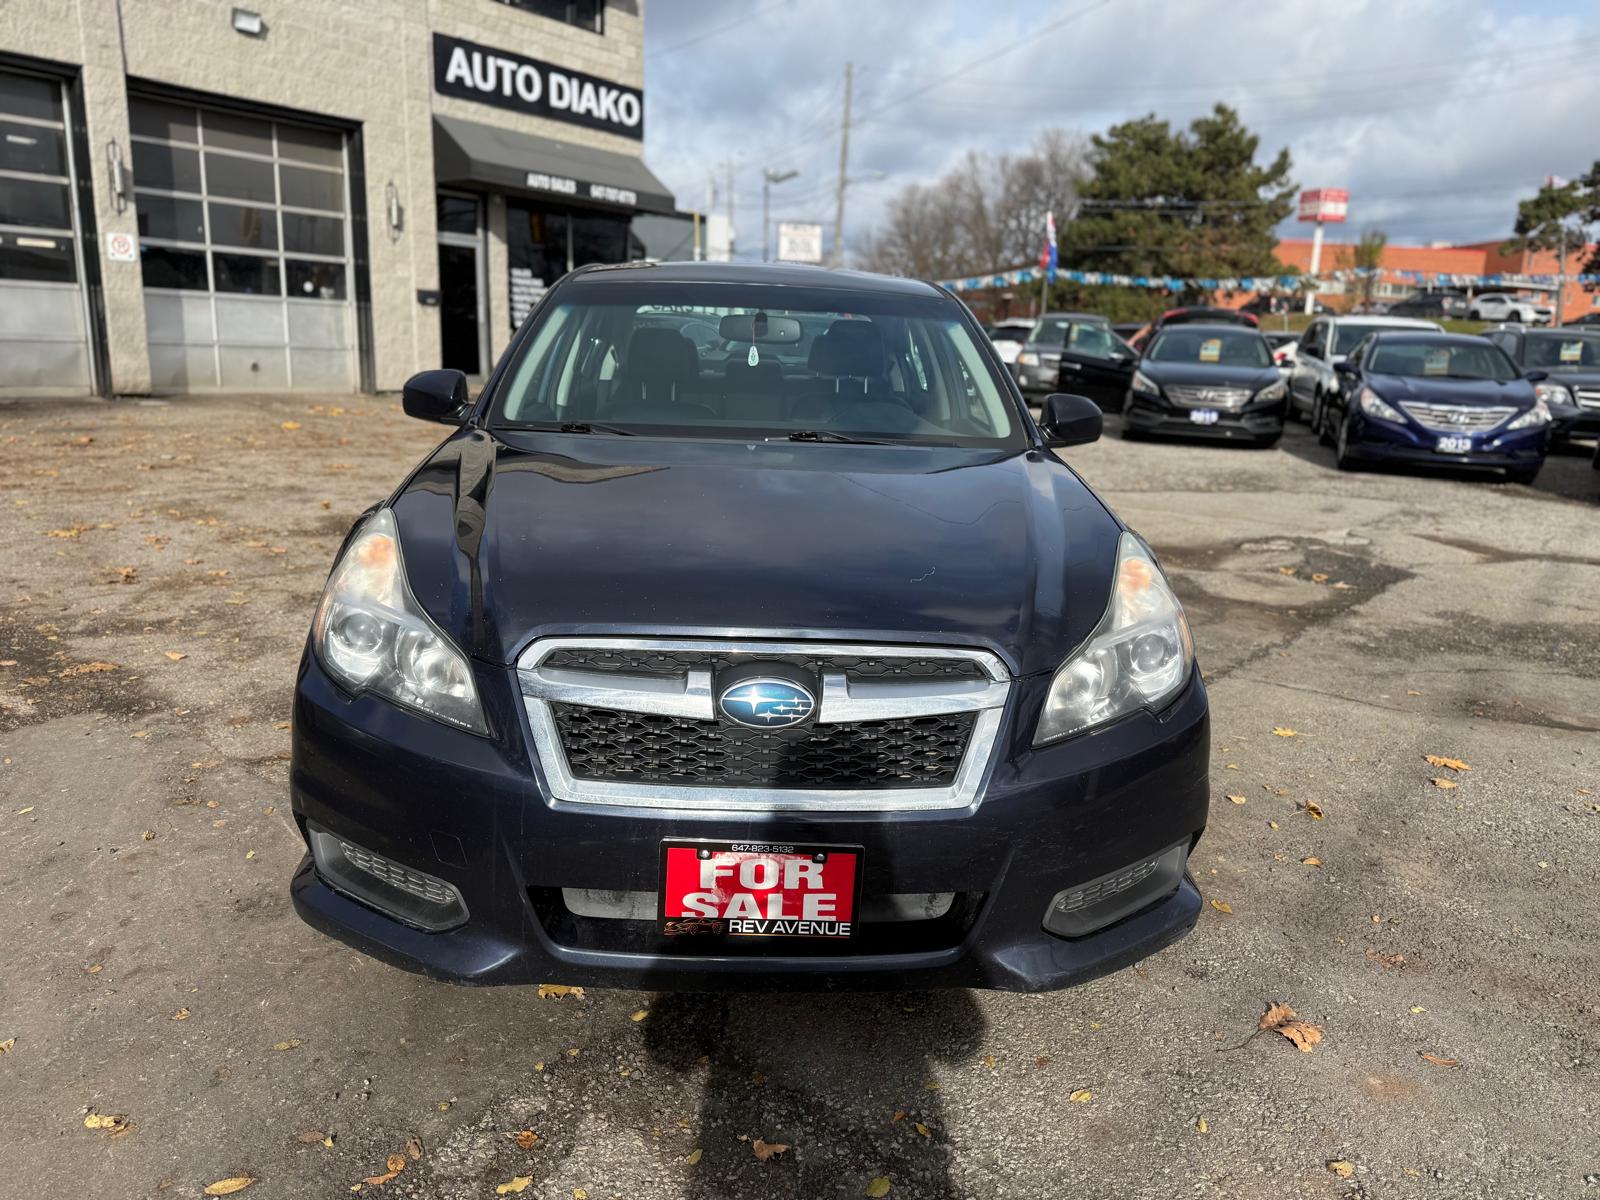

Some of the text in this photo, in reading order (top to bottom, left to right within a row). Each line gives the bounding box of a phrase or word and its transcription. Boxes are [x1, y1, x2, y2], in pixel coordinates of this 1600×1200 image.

[446, 47, 641, 126] AUTO DIAKO
[1438, 437, 1472, 451] 2013
[731, 844, 794, 853] 647-823-5132
[700, 859, 824, 890] FOR
[681, 893, 837, 920] SALE
[729, 920, 851, 936] REV AVENUE
